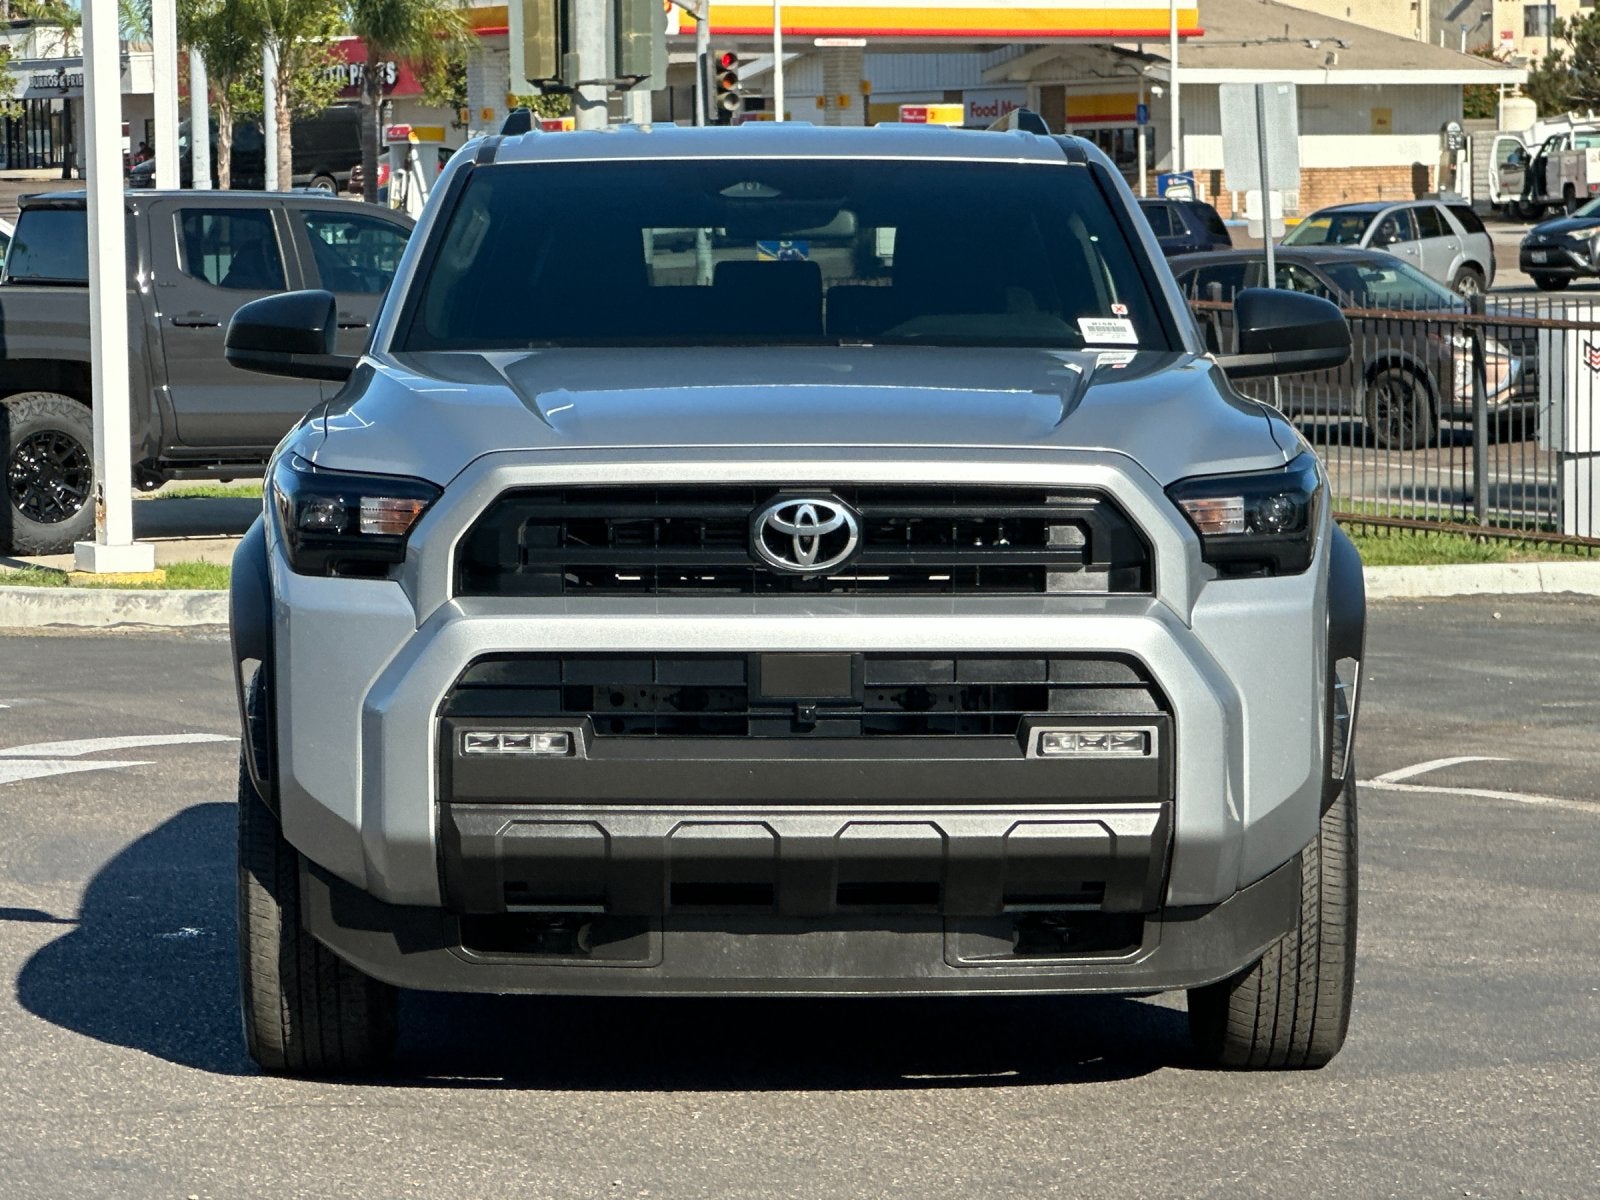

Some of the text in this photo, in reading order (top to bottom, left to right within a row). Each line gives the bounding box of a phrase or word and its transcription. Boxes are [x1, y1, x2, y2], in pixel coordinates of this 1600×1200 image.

[30, 75, 58, 88] BURROS
[67, 74, 84, 87] FRIE
[970, 98, 999, 118] Food
